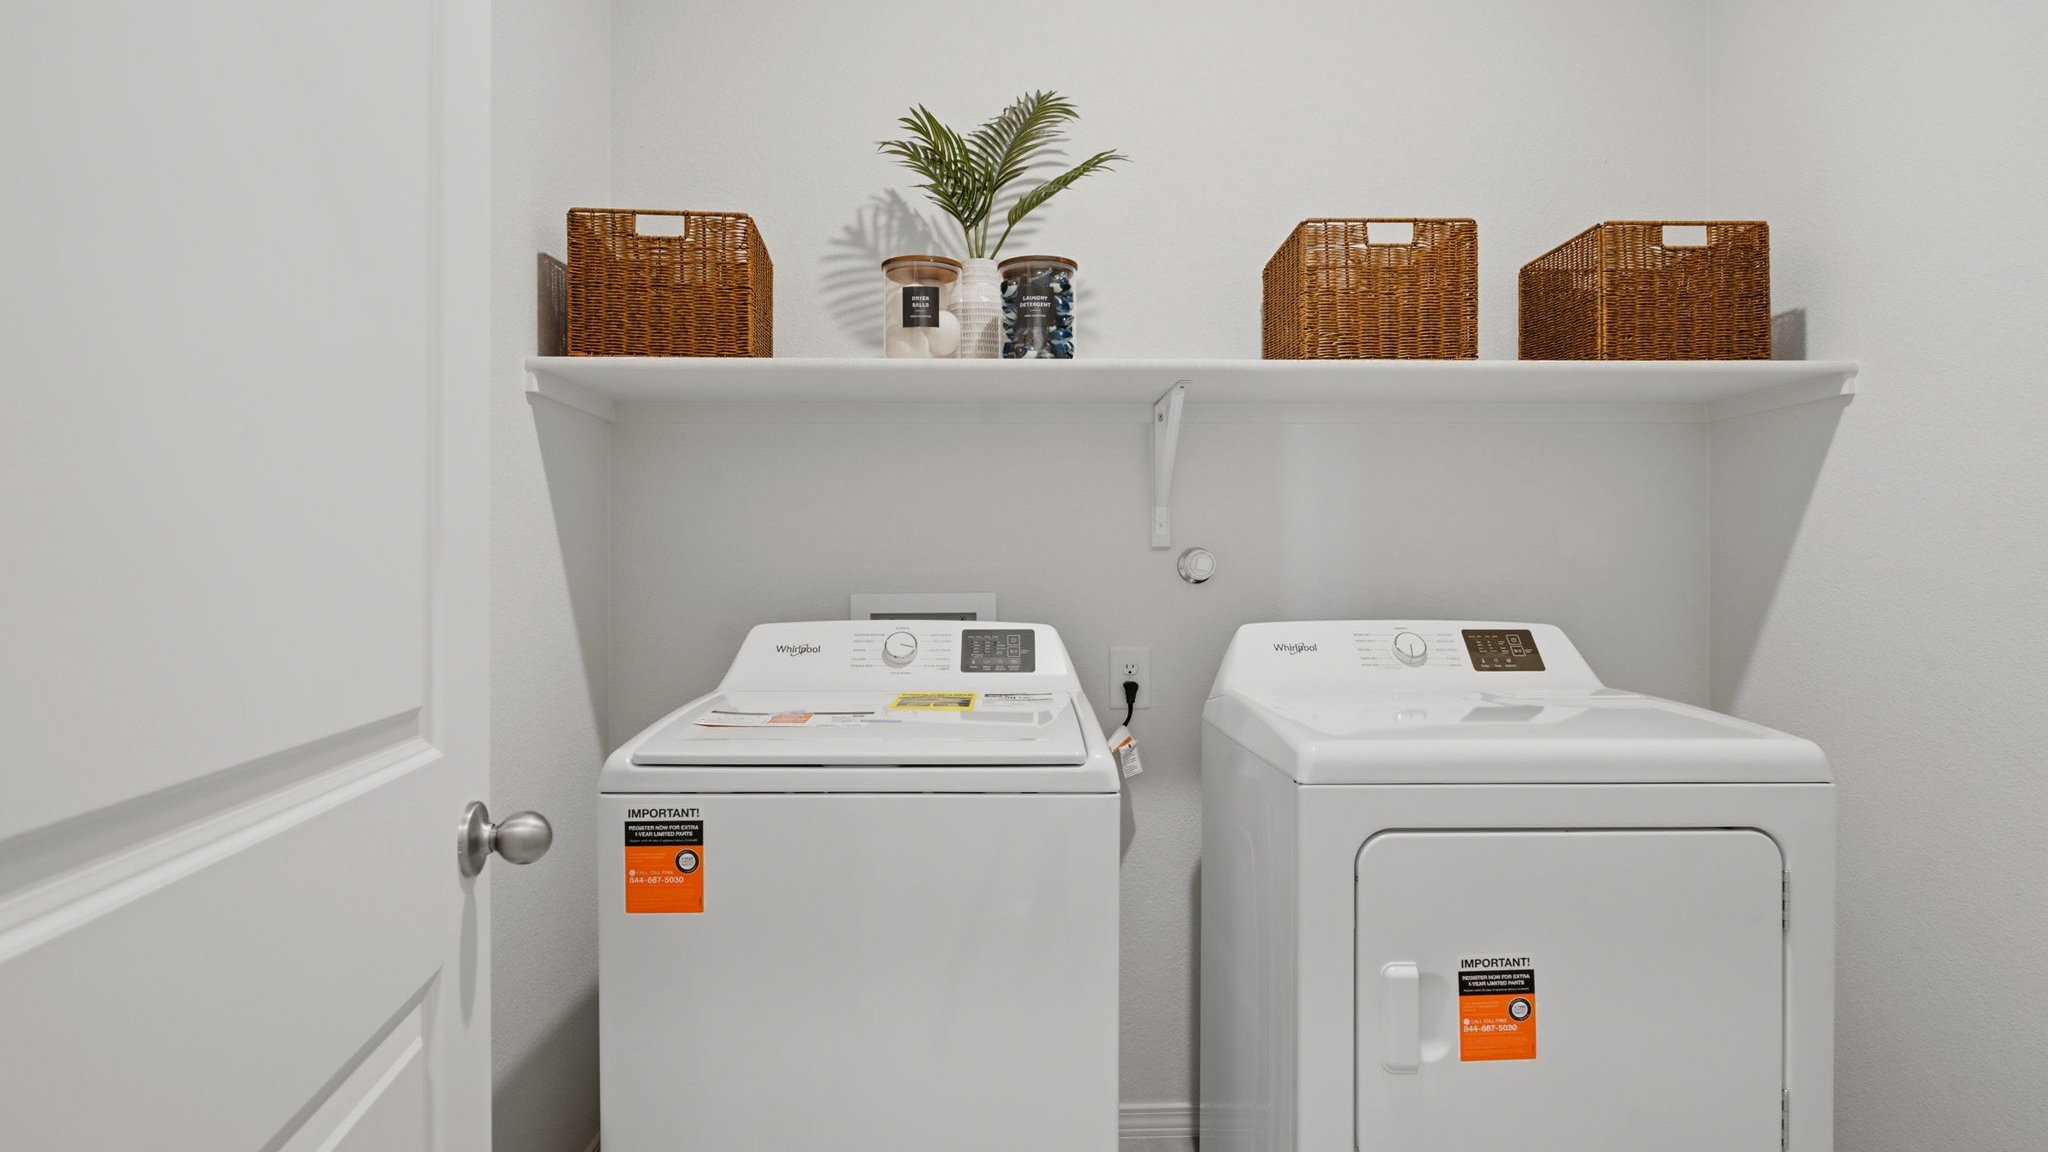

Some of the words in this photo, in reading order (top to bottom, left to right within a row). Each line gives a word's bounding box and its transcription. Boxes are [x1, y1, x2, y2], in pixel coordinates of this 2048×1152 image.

[776, 643, 821, 657] Whirlpool
[1273, 642, 1318, 656] Whirlpool
[627, 808, 700, 819] IMPORTANT!
[1461, 957, 1530, 969] IMPORTANT!
